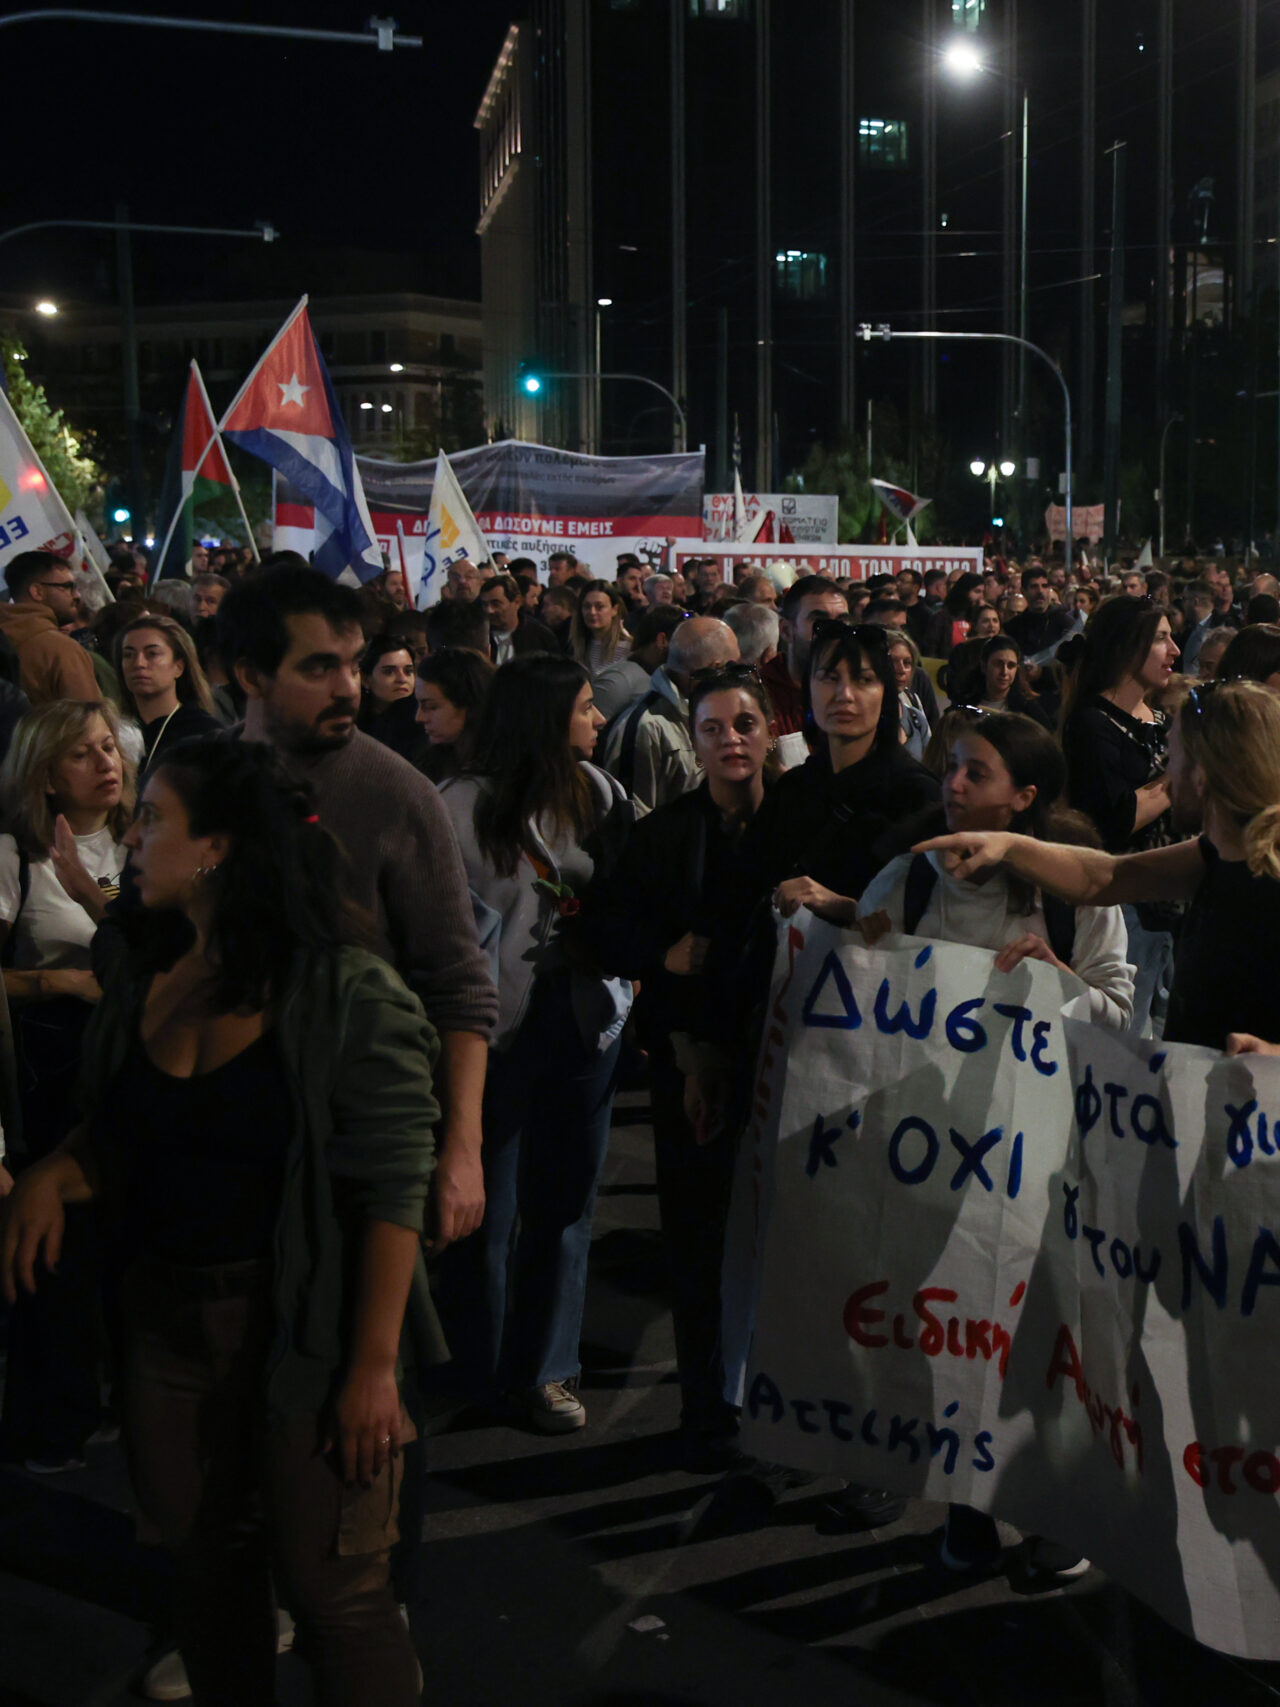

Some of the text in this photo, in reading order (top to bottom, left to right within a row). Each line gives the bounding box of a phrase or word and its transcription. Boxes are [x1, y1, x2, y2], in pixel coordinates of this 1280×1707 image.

[493, 516, 564, 535] ΔΩΣΟΥΜΕ
[567, 520, 614, 536] ΕΜΕΙΣ
[802, 946, 1060, 1076] Δώστε
[888, 1115, 1024, 1200] ΟΧΙ
[842, 1282, 1026, 1380] Ειδική
[747, 1372, 996, 1474] Αττικής
